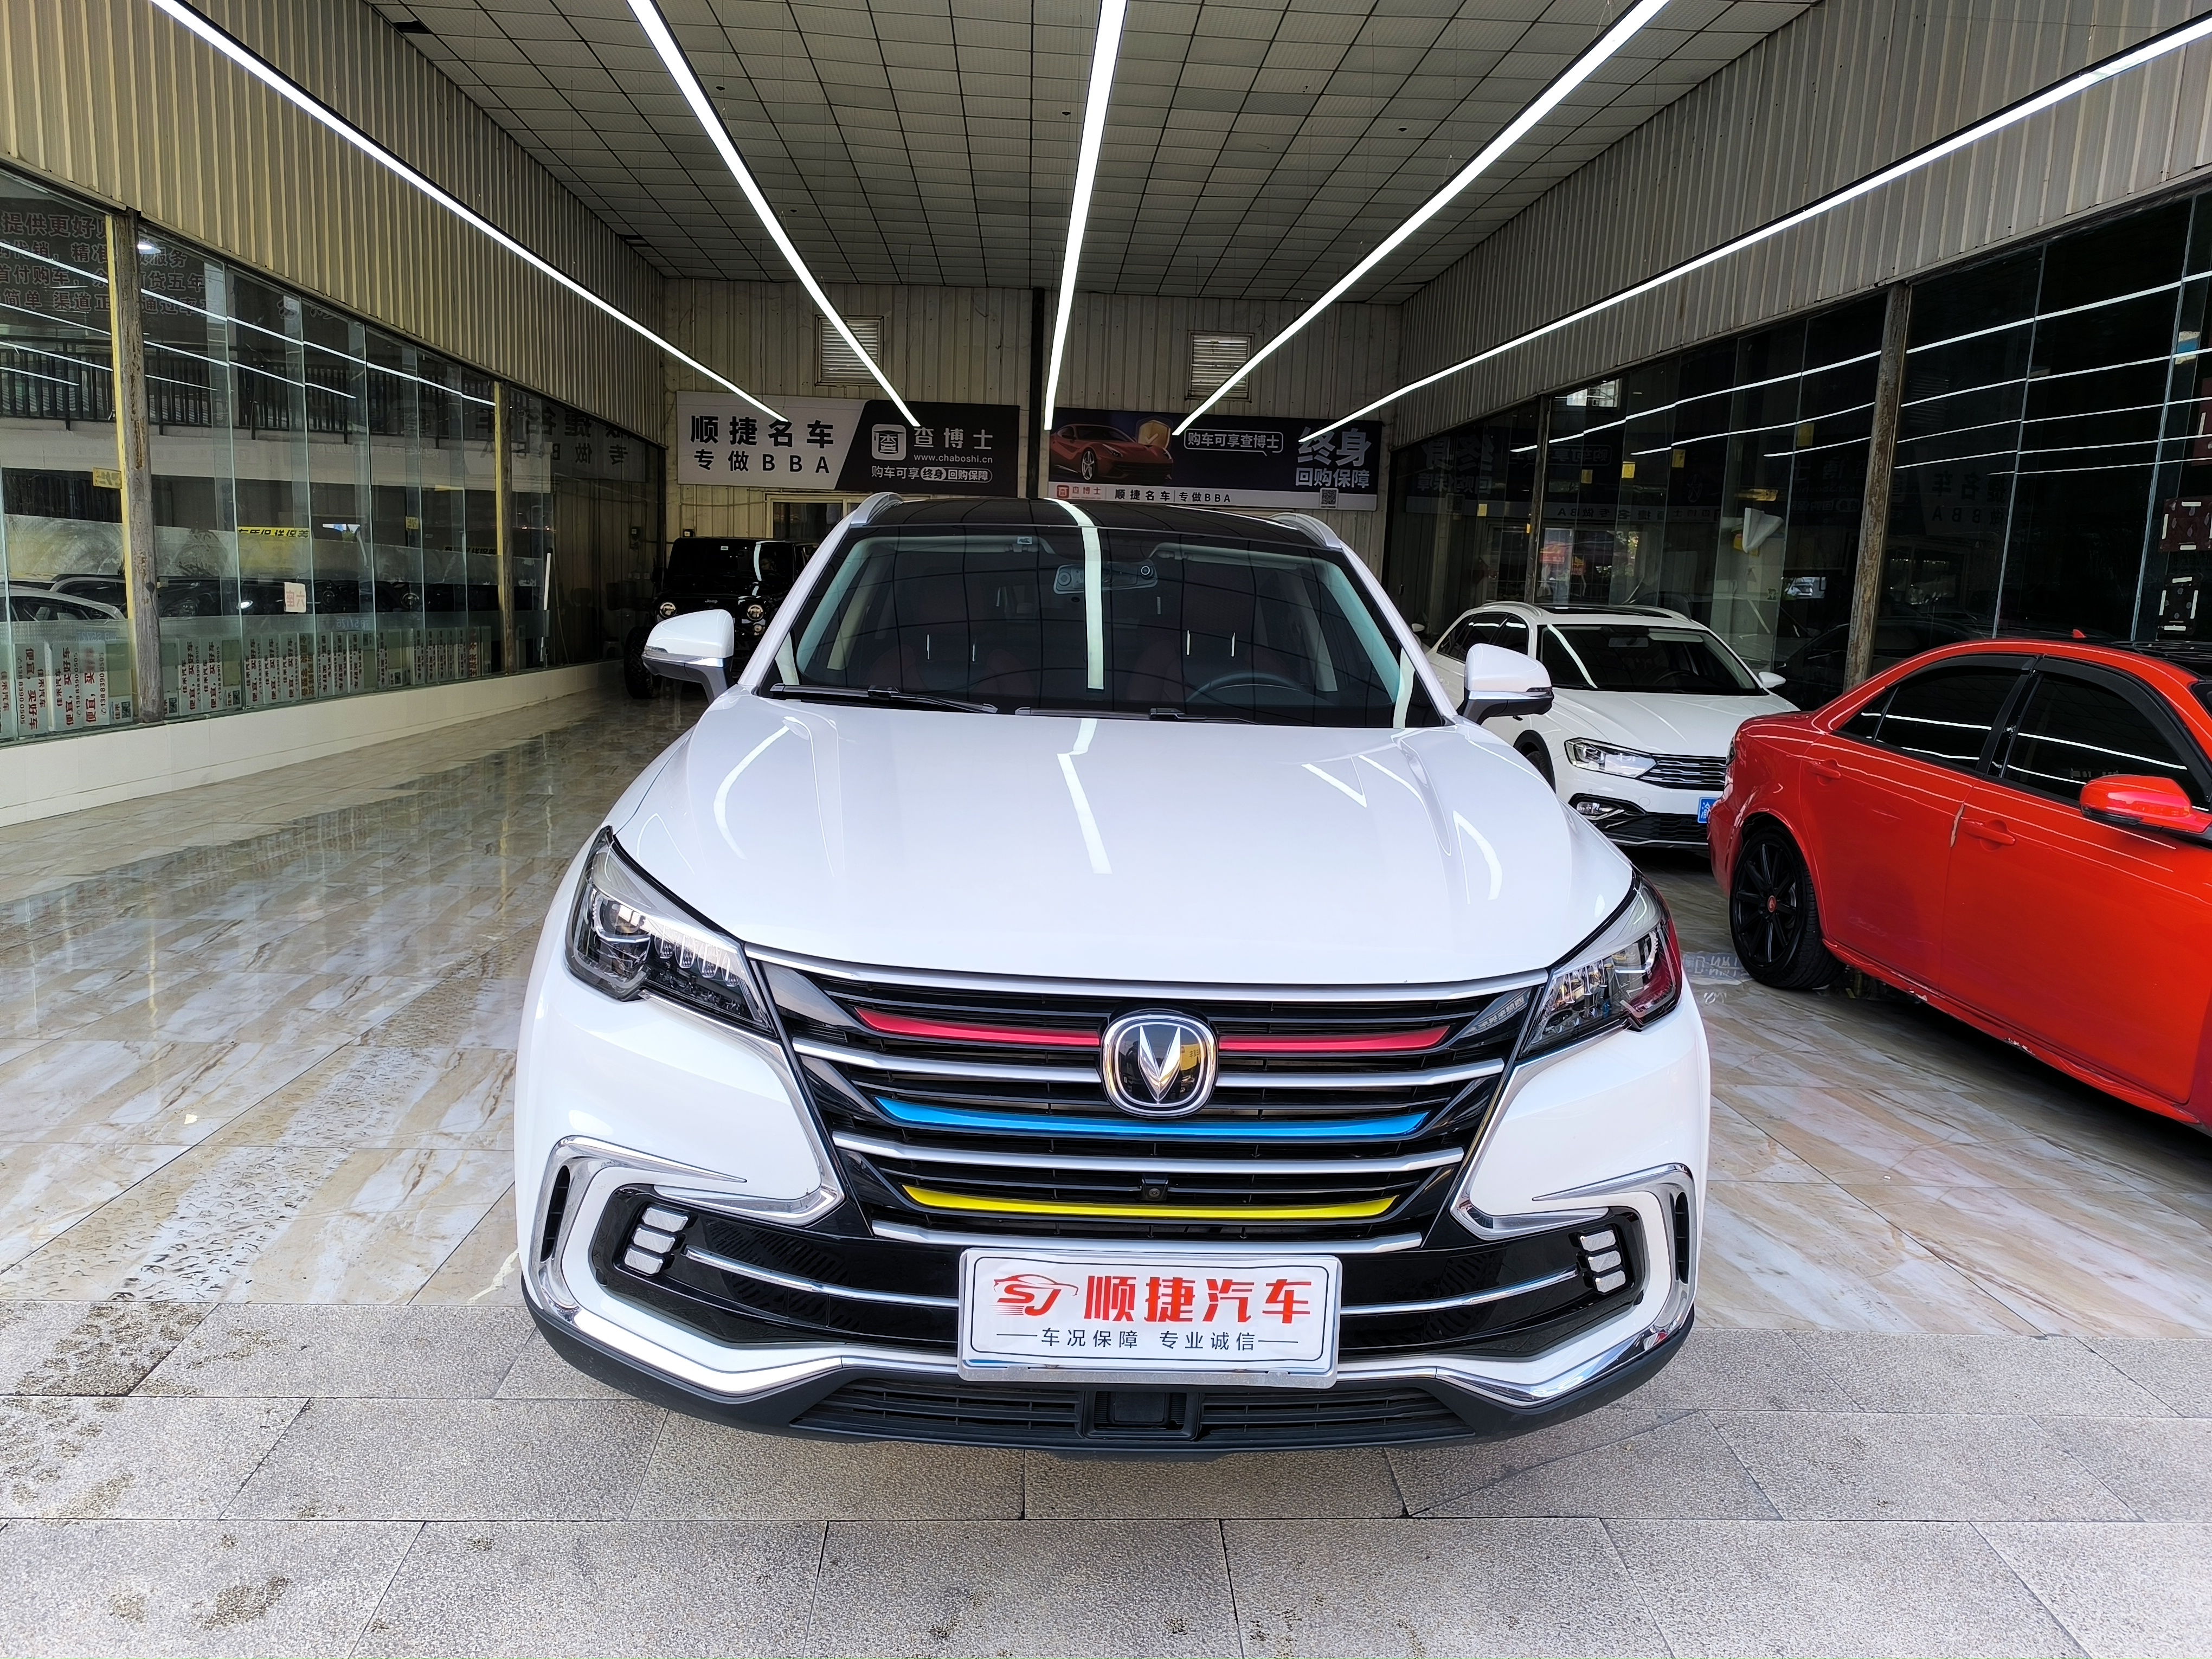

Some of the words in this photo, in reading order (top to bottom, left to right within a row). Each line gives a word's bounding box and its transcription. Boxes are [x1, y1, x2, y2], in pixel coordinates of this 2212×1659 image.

[690, 415, 834, 448] 顺捷名车
[914, 427, 993, 449] 查博士
[1188, 432, 1279, 449] 购车可享查博士
[1297, 426, 1371, 467] 终身
[695, 449, 829, 474] 专做BBA
[914, 454, 993, 463] www.chaboshi.cn
[1295, 467, 1371, 488] 回购保障
[1072, 486, 1101, 495] 查博士
[1115, 489, 1171, 501] 顺捷名车
[1179, 492, 1230, 503] 专做BBA
[1084, 1275, 1312, 1324] 顺捷汽车
[1041, 1327, 1139, 1348] 车况保障
[1158, 1330, 1256, 1351] 专业诚信
